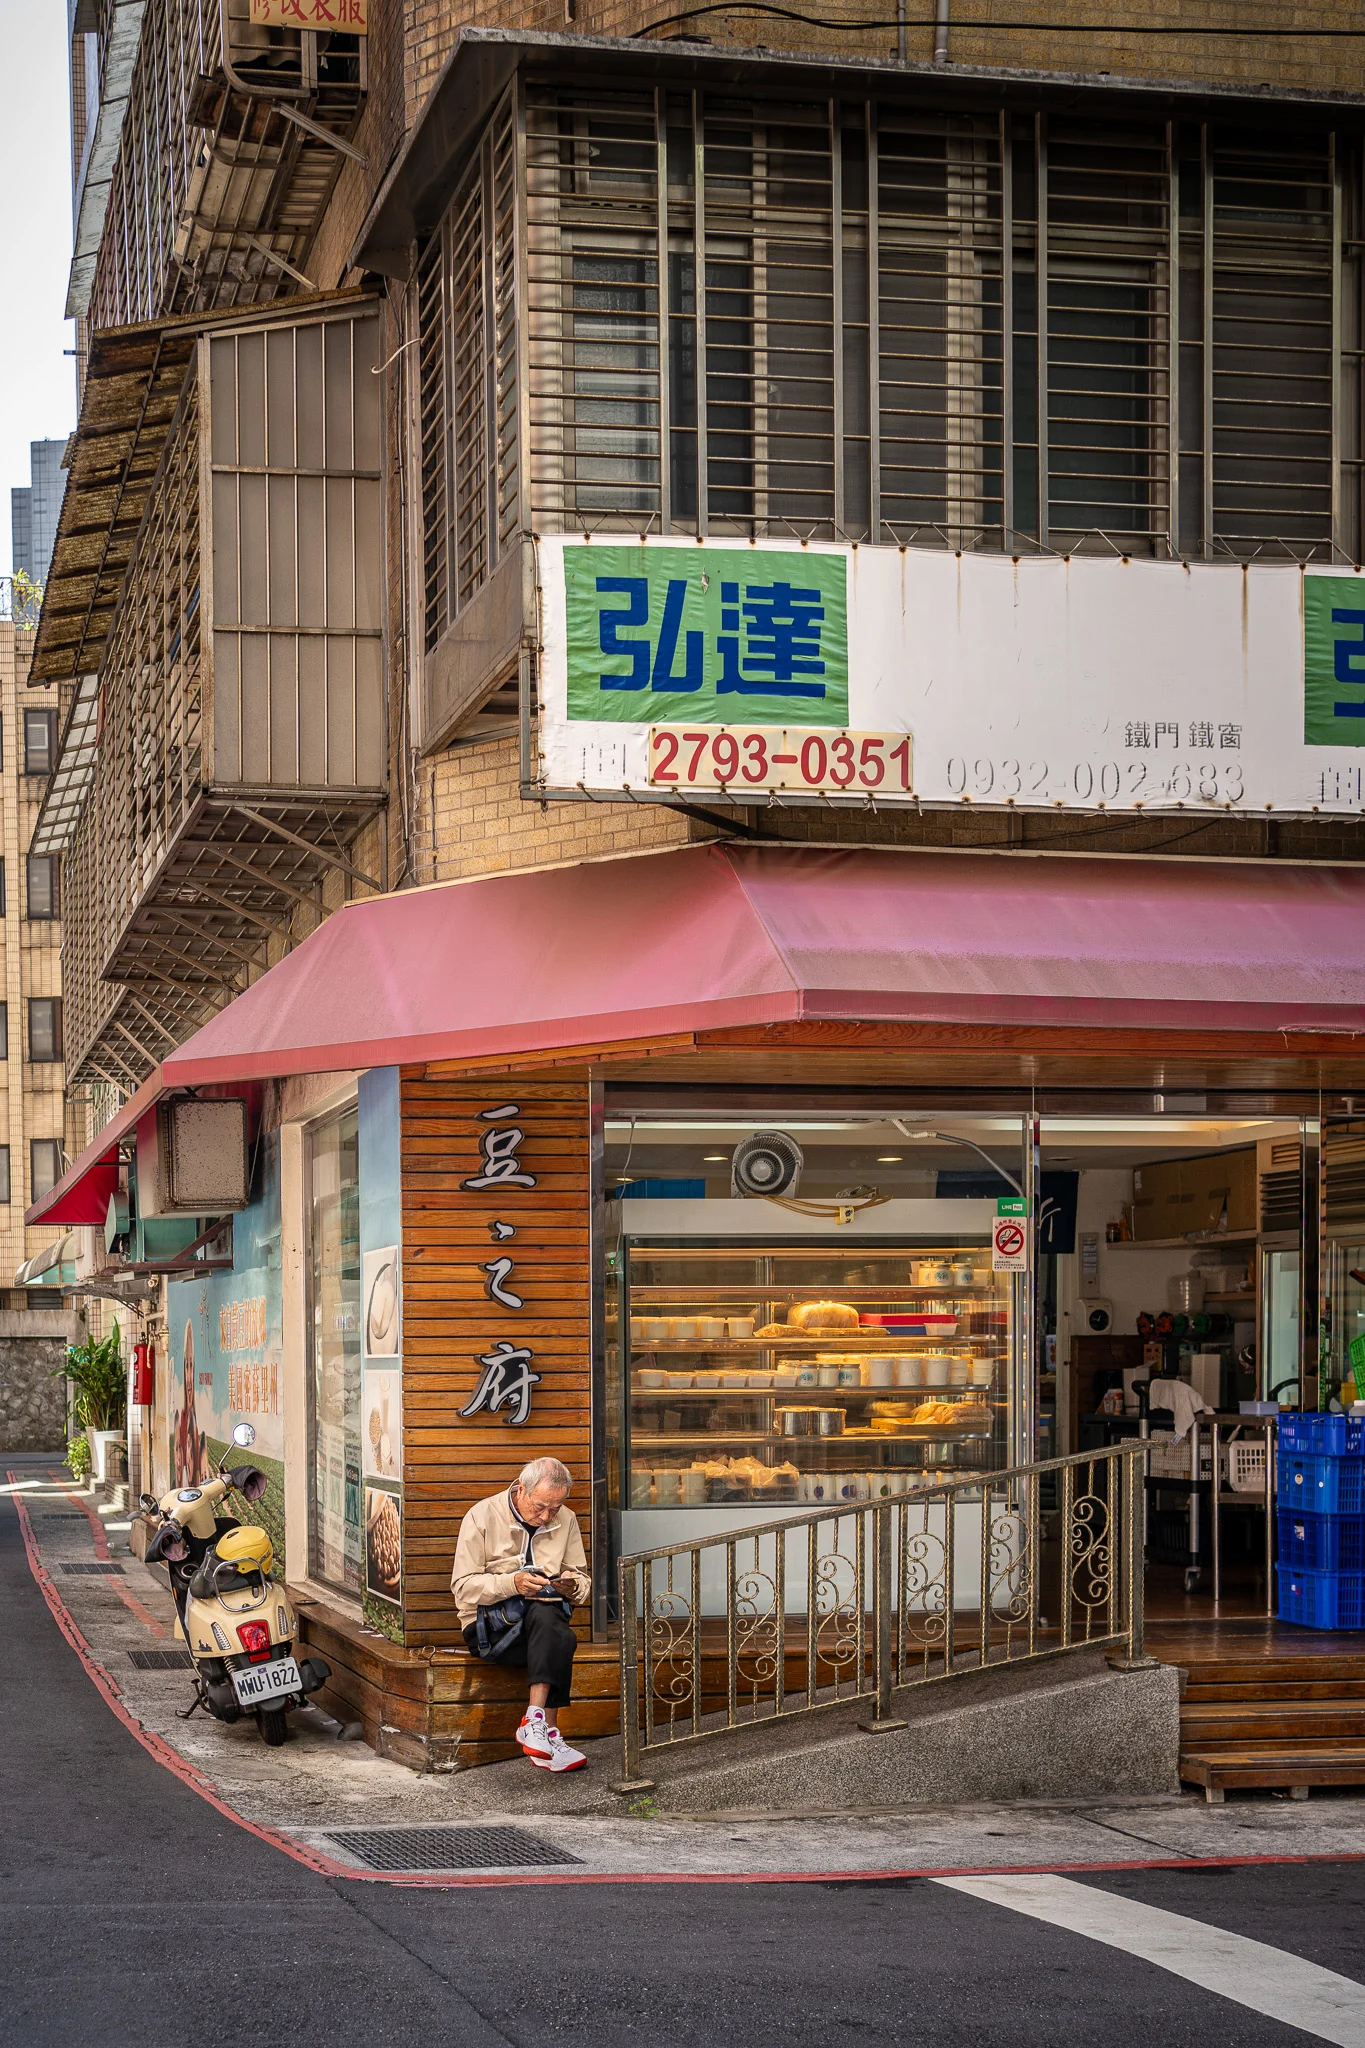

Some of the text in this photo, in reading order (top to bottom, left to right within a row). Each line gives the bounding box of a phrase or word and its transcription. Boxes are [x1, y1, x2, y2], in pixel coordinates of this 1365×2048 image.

[595, 577, 826, 698] 弘達
[652, 732, 910, 788] 2793-0351
[1124, 721, 1243, 750] 鐵門 鐵窗
[458, 1103, 542, 1425] 豆之府
